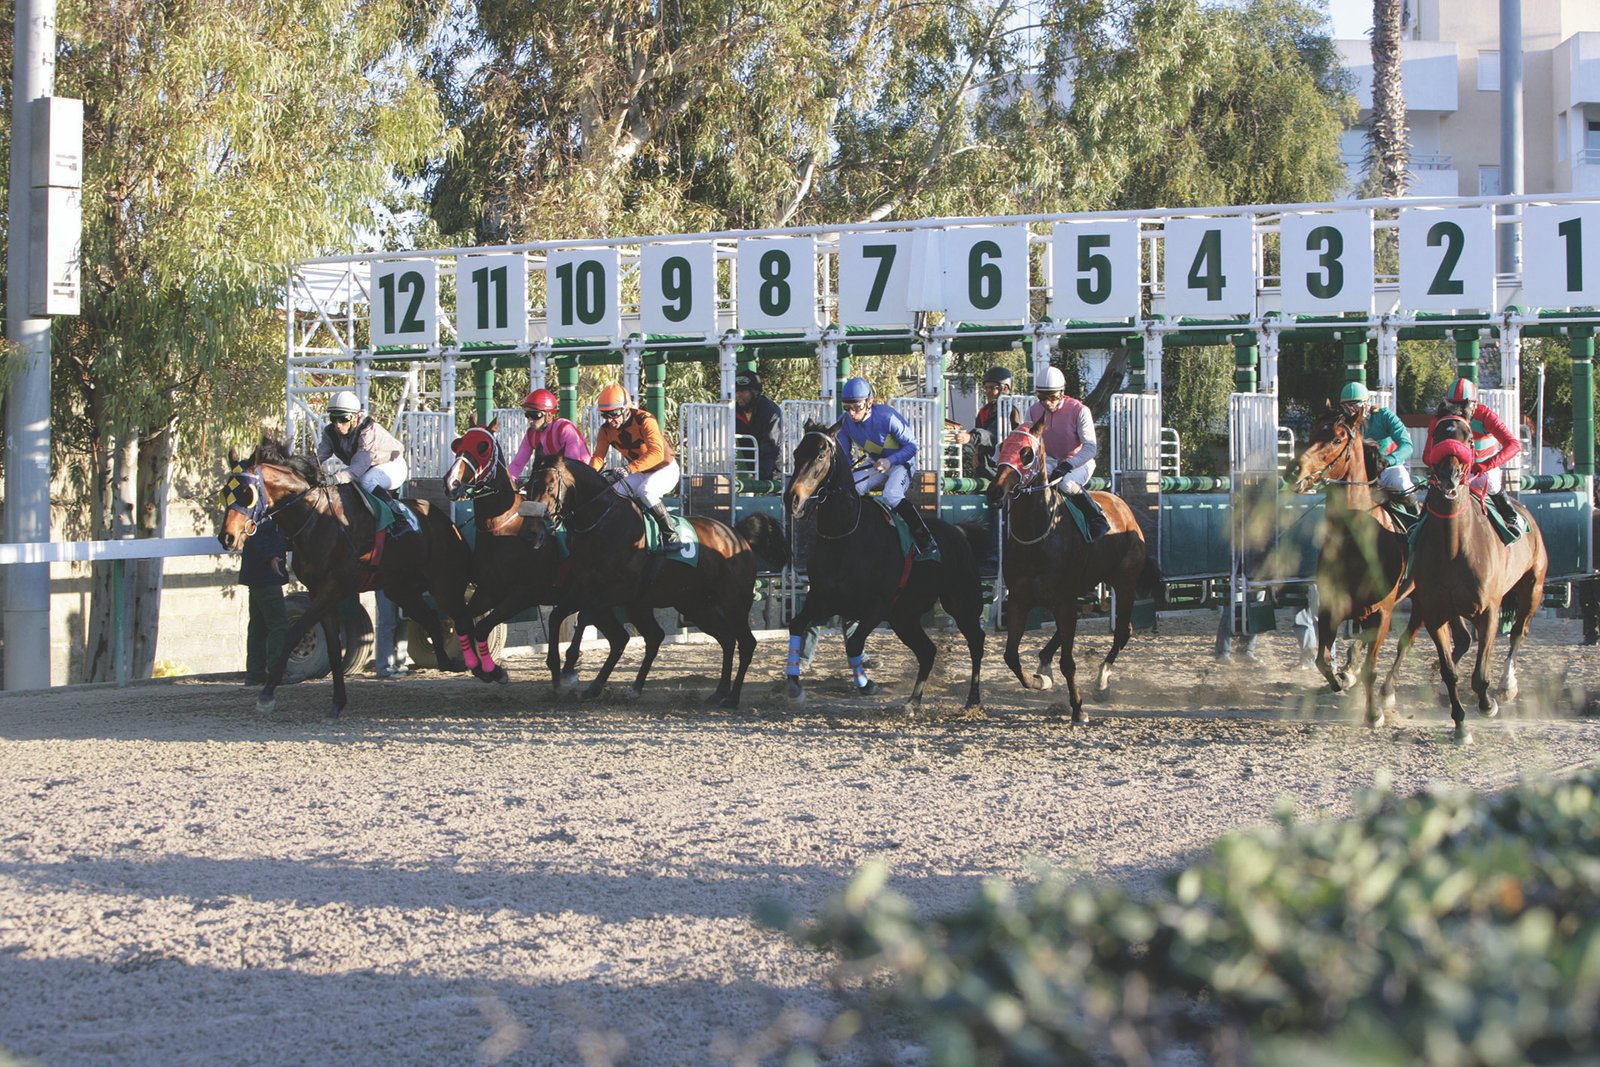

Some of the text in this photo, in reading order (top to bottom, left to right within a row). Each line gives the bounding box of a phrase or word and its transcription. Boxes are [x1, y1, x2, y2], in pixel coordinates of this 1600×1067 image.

[760, 250, 790, 316] 8
[863, 245, 897, 311] 7
[969, 241, 1002, 310] 6
[1077, 235, 1111, 304] 5
[1188, 230, 1226, 301] 4
[1307, 226, 1344, 299] 3
[1427, 222, 1465, 295] 2
[1559, 218, 1583, 292] 1
[379, 271, 425, 332] 12
[472, 266, 508, 330] 11
[556, 260, 605, 325] 10
[662, 257, 692, 322] 9
